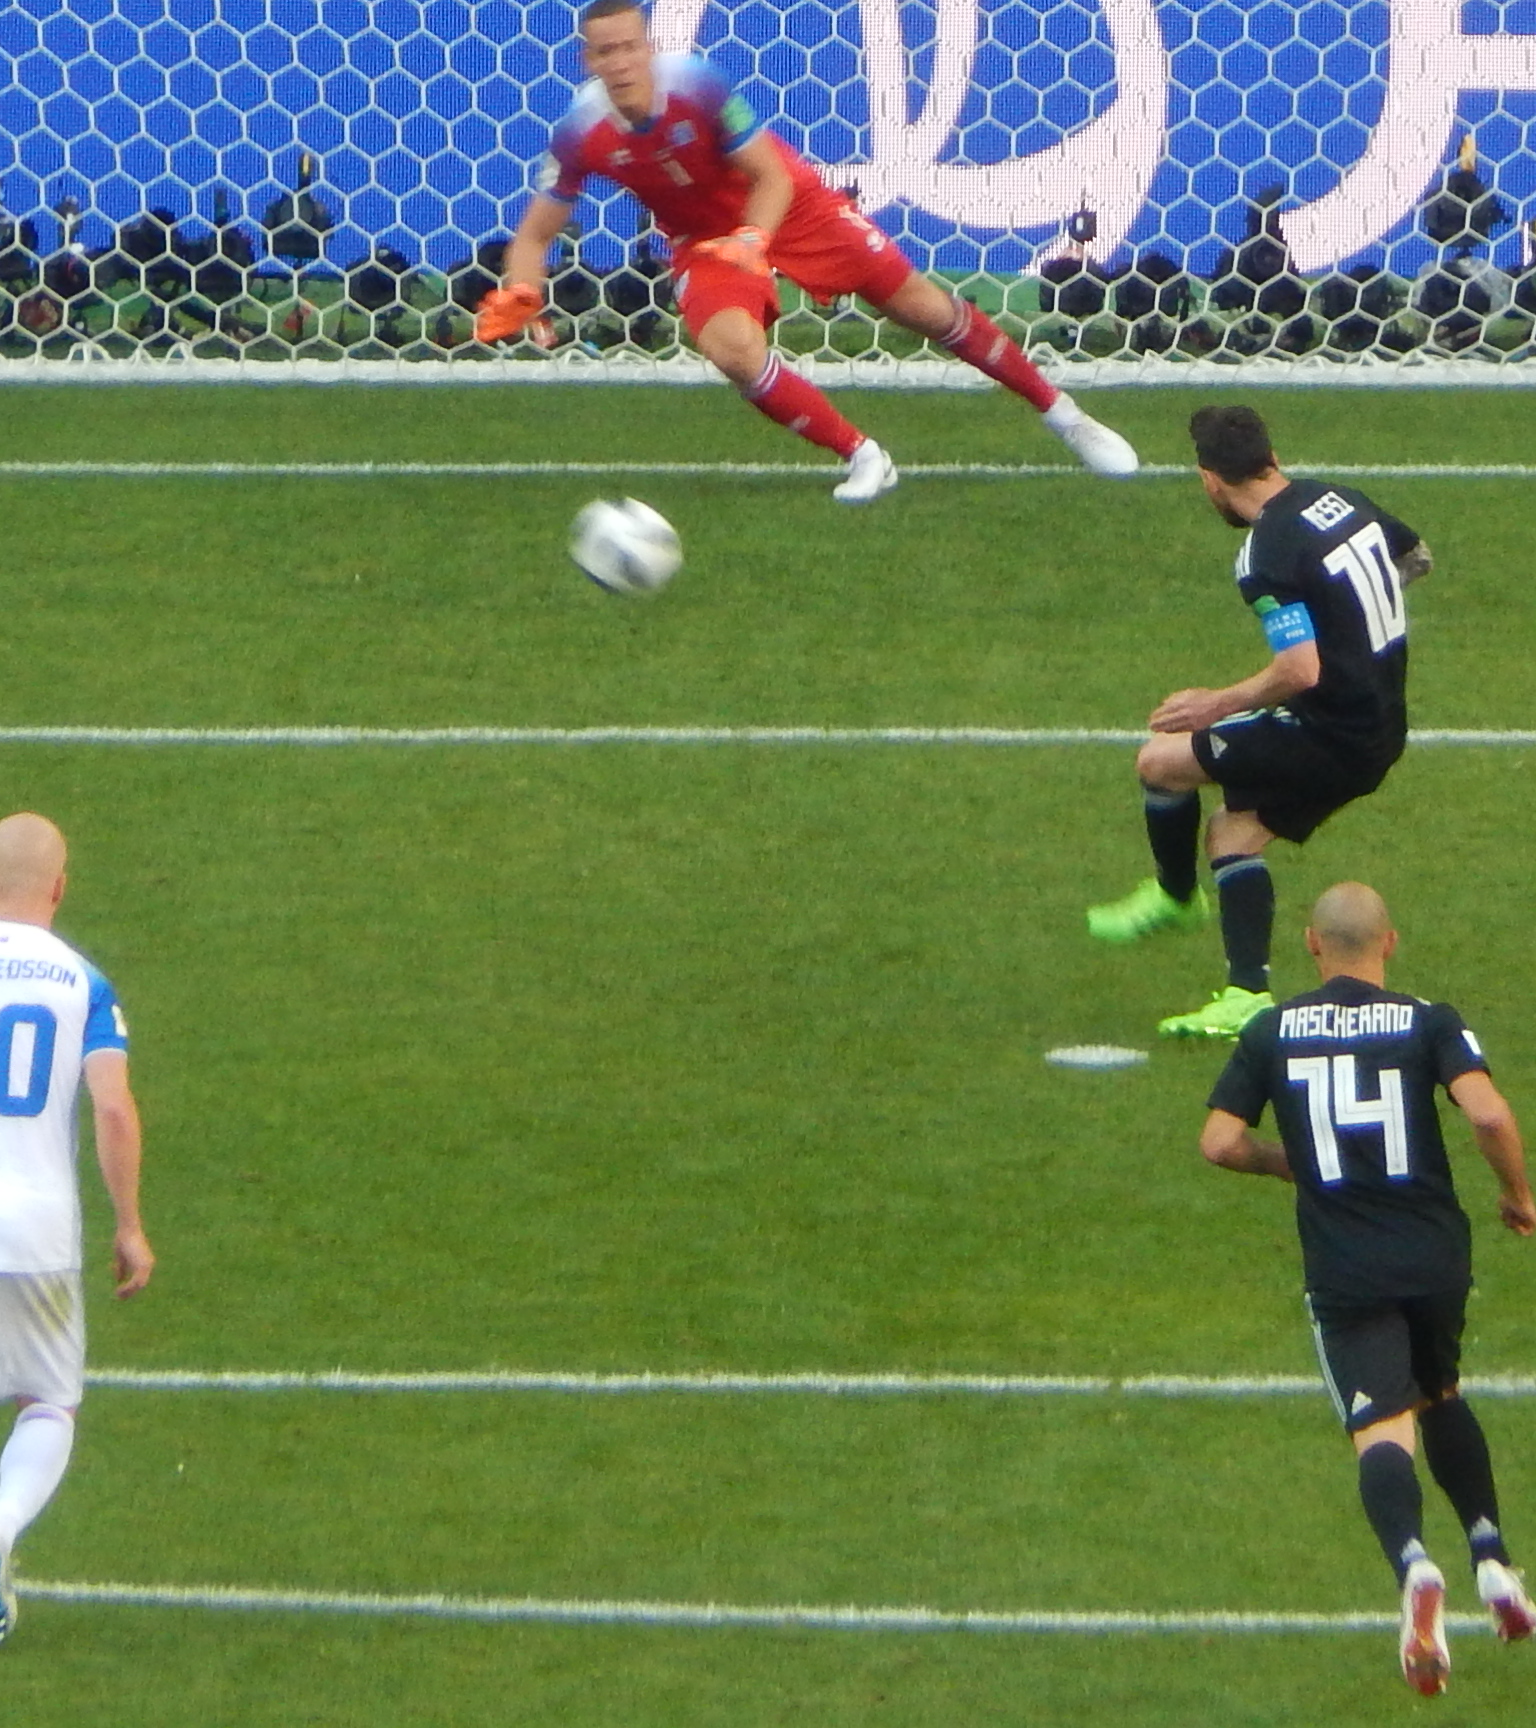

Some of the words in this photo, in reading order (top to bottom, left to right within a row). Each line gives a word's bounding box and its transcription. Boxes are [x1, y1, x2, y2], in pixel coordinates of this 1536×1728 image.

[1323, 521, 1407, 653] 10
[1279, 1002, 1413, 1038] MASCHERANO
[1286, 1053, 1409, 1183] 14
